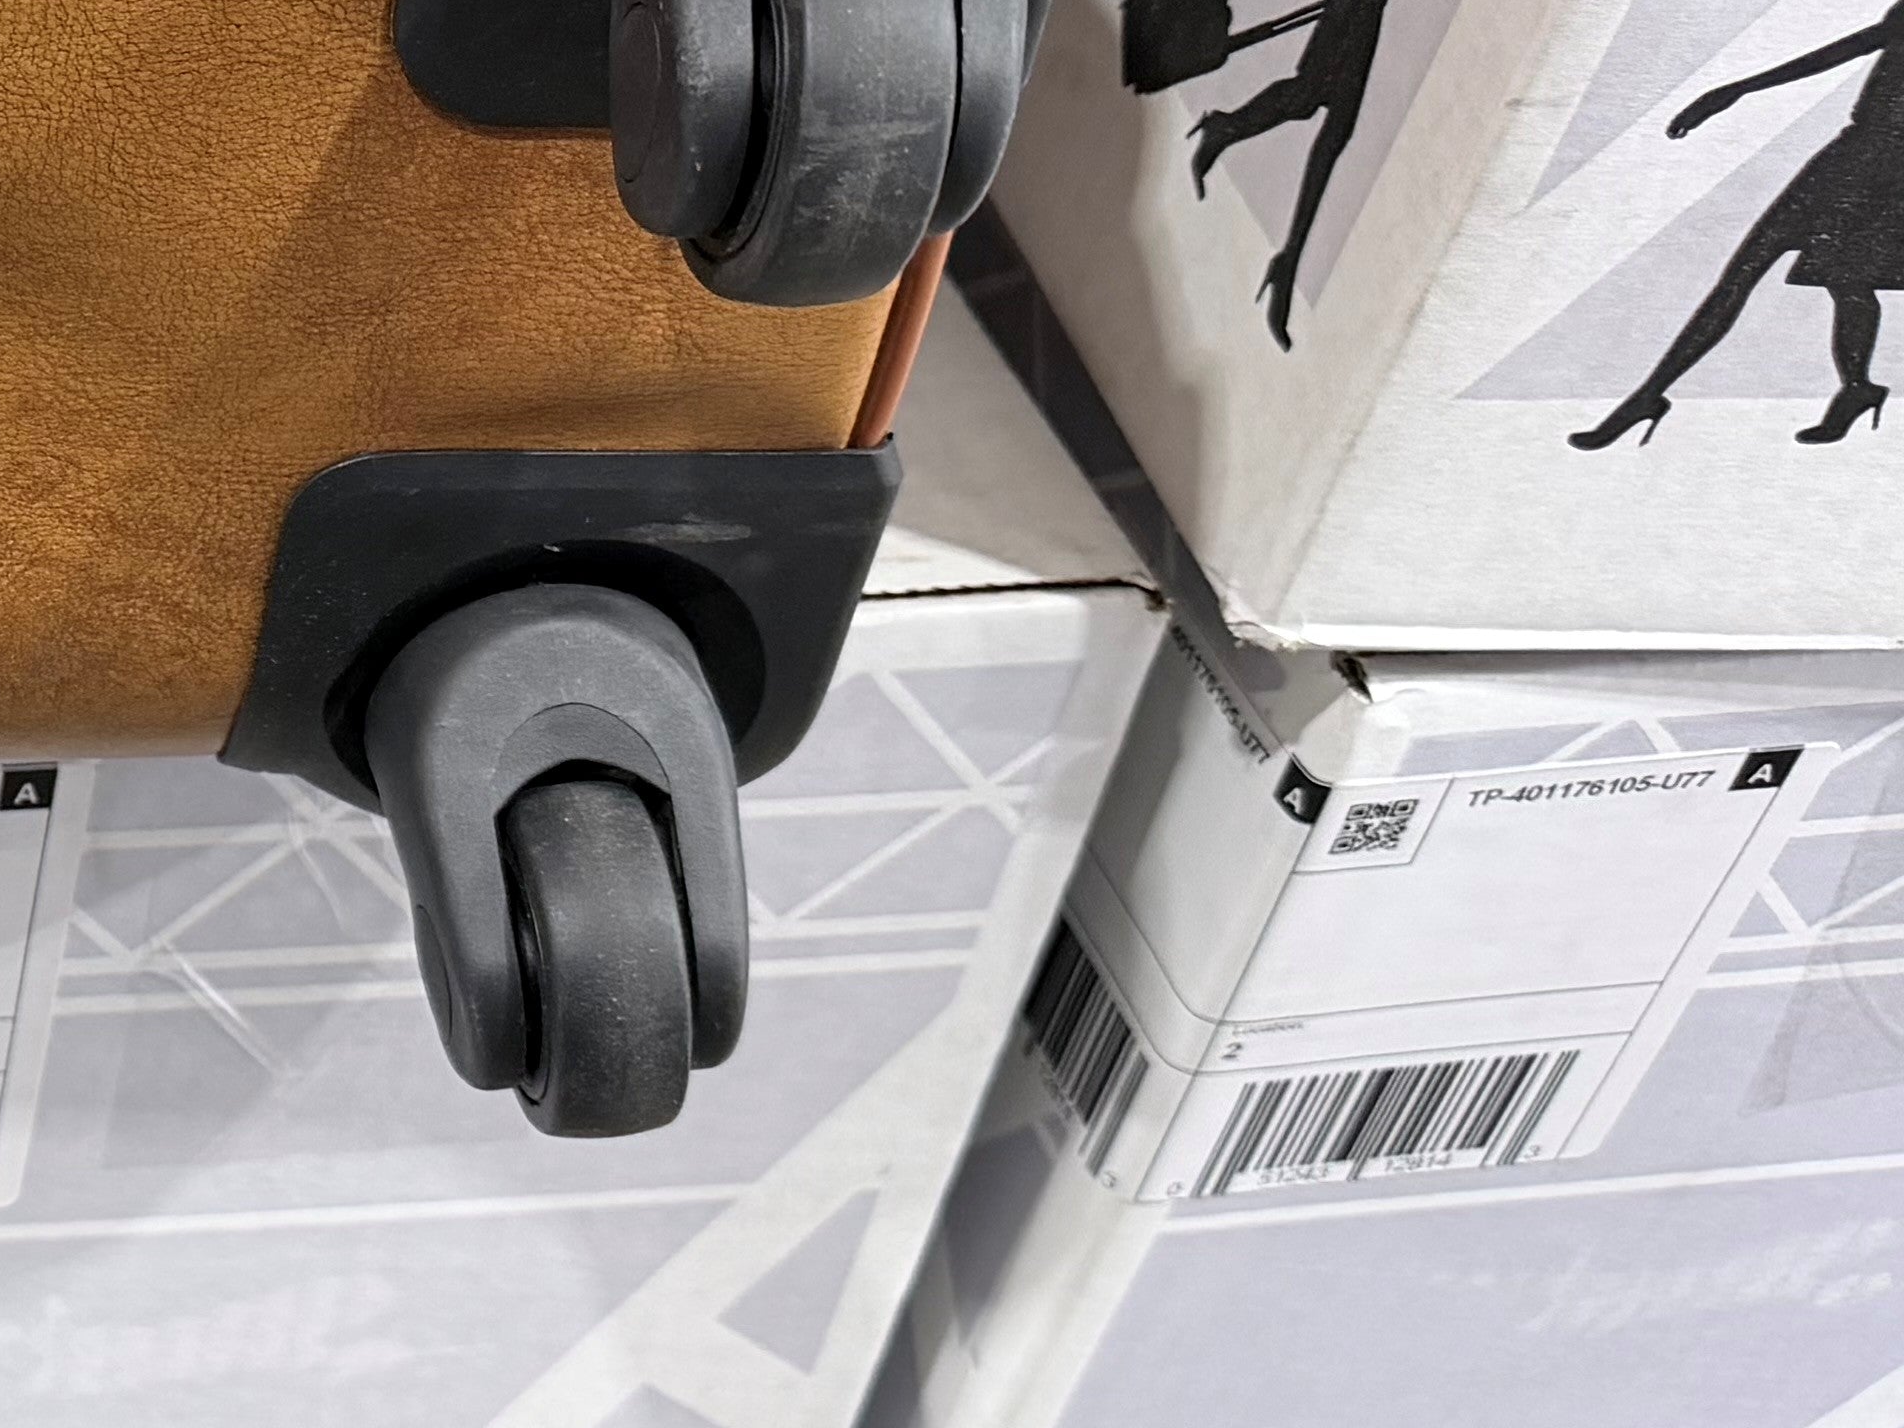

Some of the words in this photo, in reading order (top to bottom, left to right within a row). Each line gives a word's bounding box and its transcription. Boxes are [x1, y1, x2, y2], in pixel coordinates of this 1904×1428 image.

[13, 783, 41, 805] A
[1283, 786, 1303, 815] A
[1468, 769, 1716, 808] TP-401176105-U77
[1747, 763, 1773, 785] A
[1222, 1041, 1242, 1060] 2
